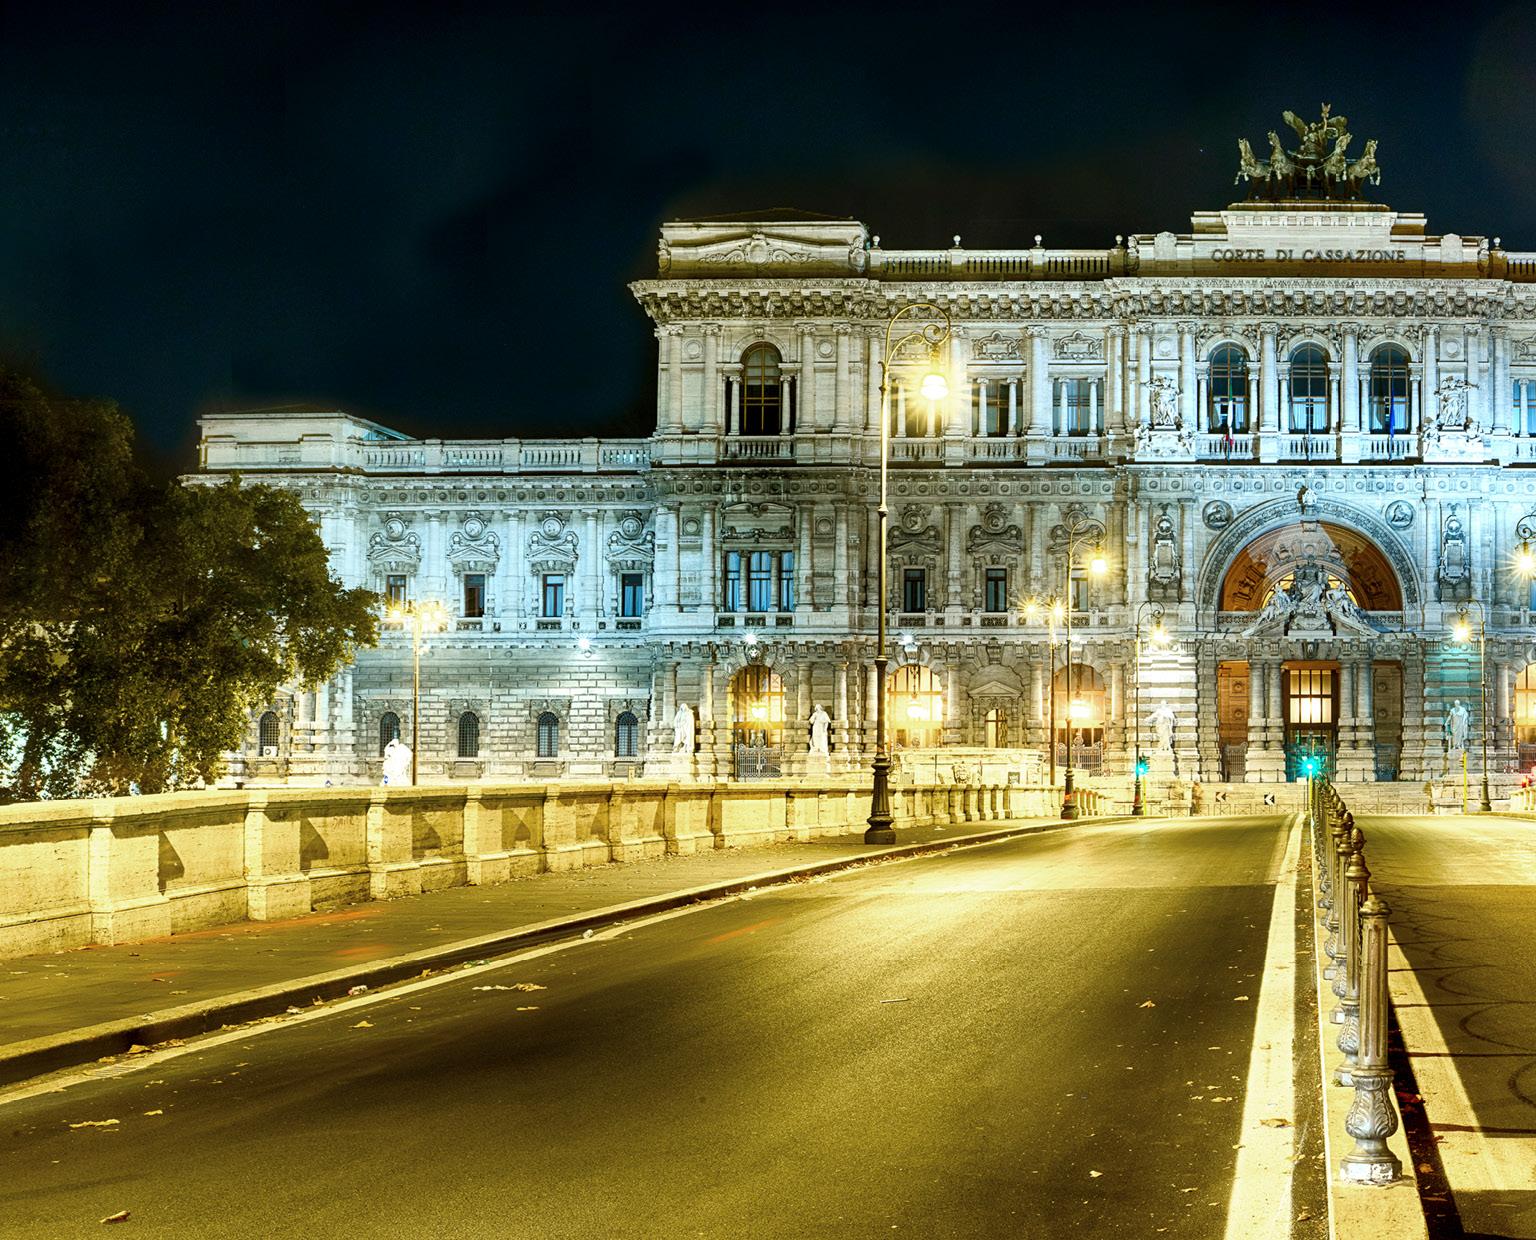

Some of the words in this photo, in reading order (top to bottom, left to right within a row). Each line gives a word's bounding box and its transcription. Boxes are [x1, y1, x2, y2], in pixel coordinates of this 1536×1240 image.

[1210, 248, 1266, 263] CORTE
[1275, 248, 1294, 263] DI
[1301, 248, 1406, 264] CASSAZIONE
